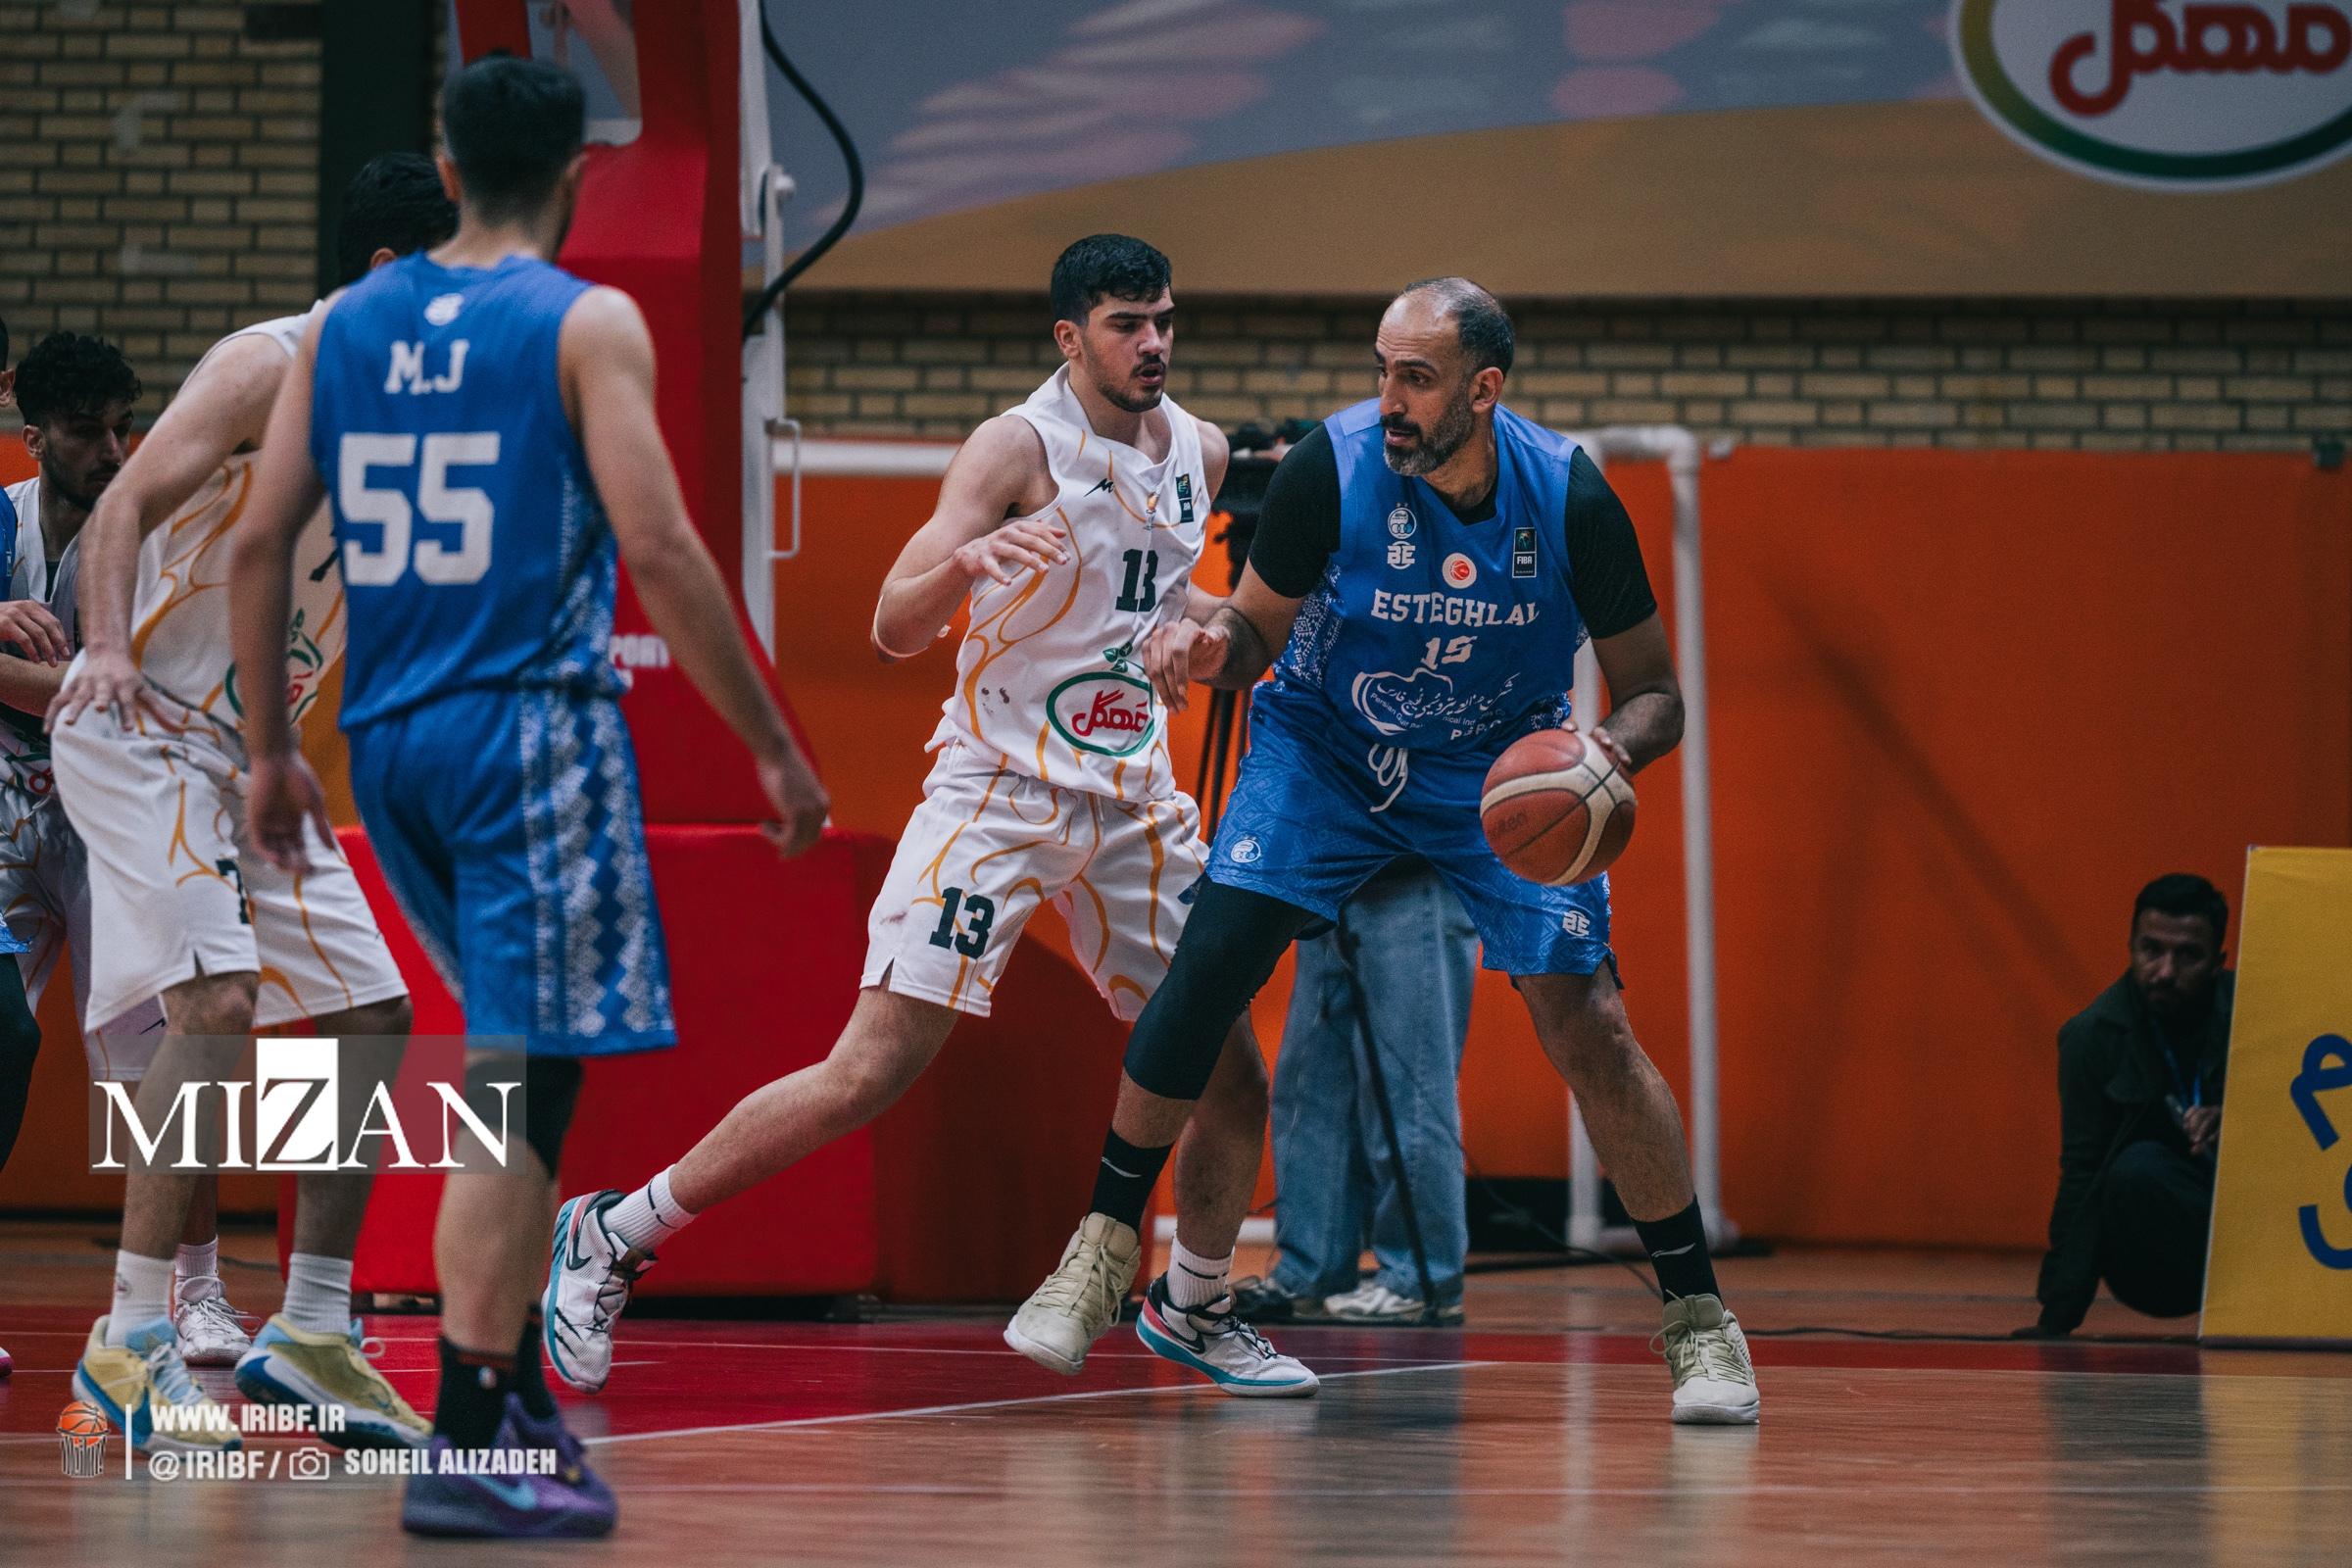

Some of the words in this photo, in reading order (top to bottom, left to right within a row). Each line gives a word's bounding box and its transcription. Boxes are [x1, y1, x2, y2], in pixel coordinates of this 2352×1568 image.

[339, 431, 500, 586] 55
[1115, 548, 1159, 613] 13
[1516, 556, 1533, 564] FIBA
[1420, 635, 1478, 670] 15
[1370, 692, 1396, 716] Persian
[930, 887, 995, 960] 13
